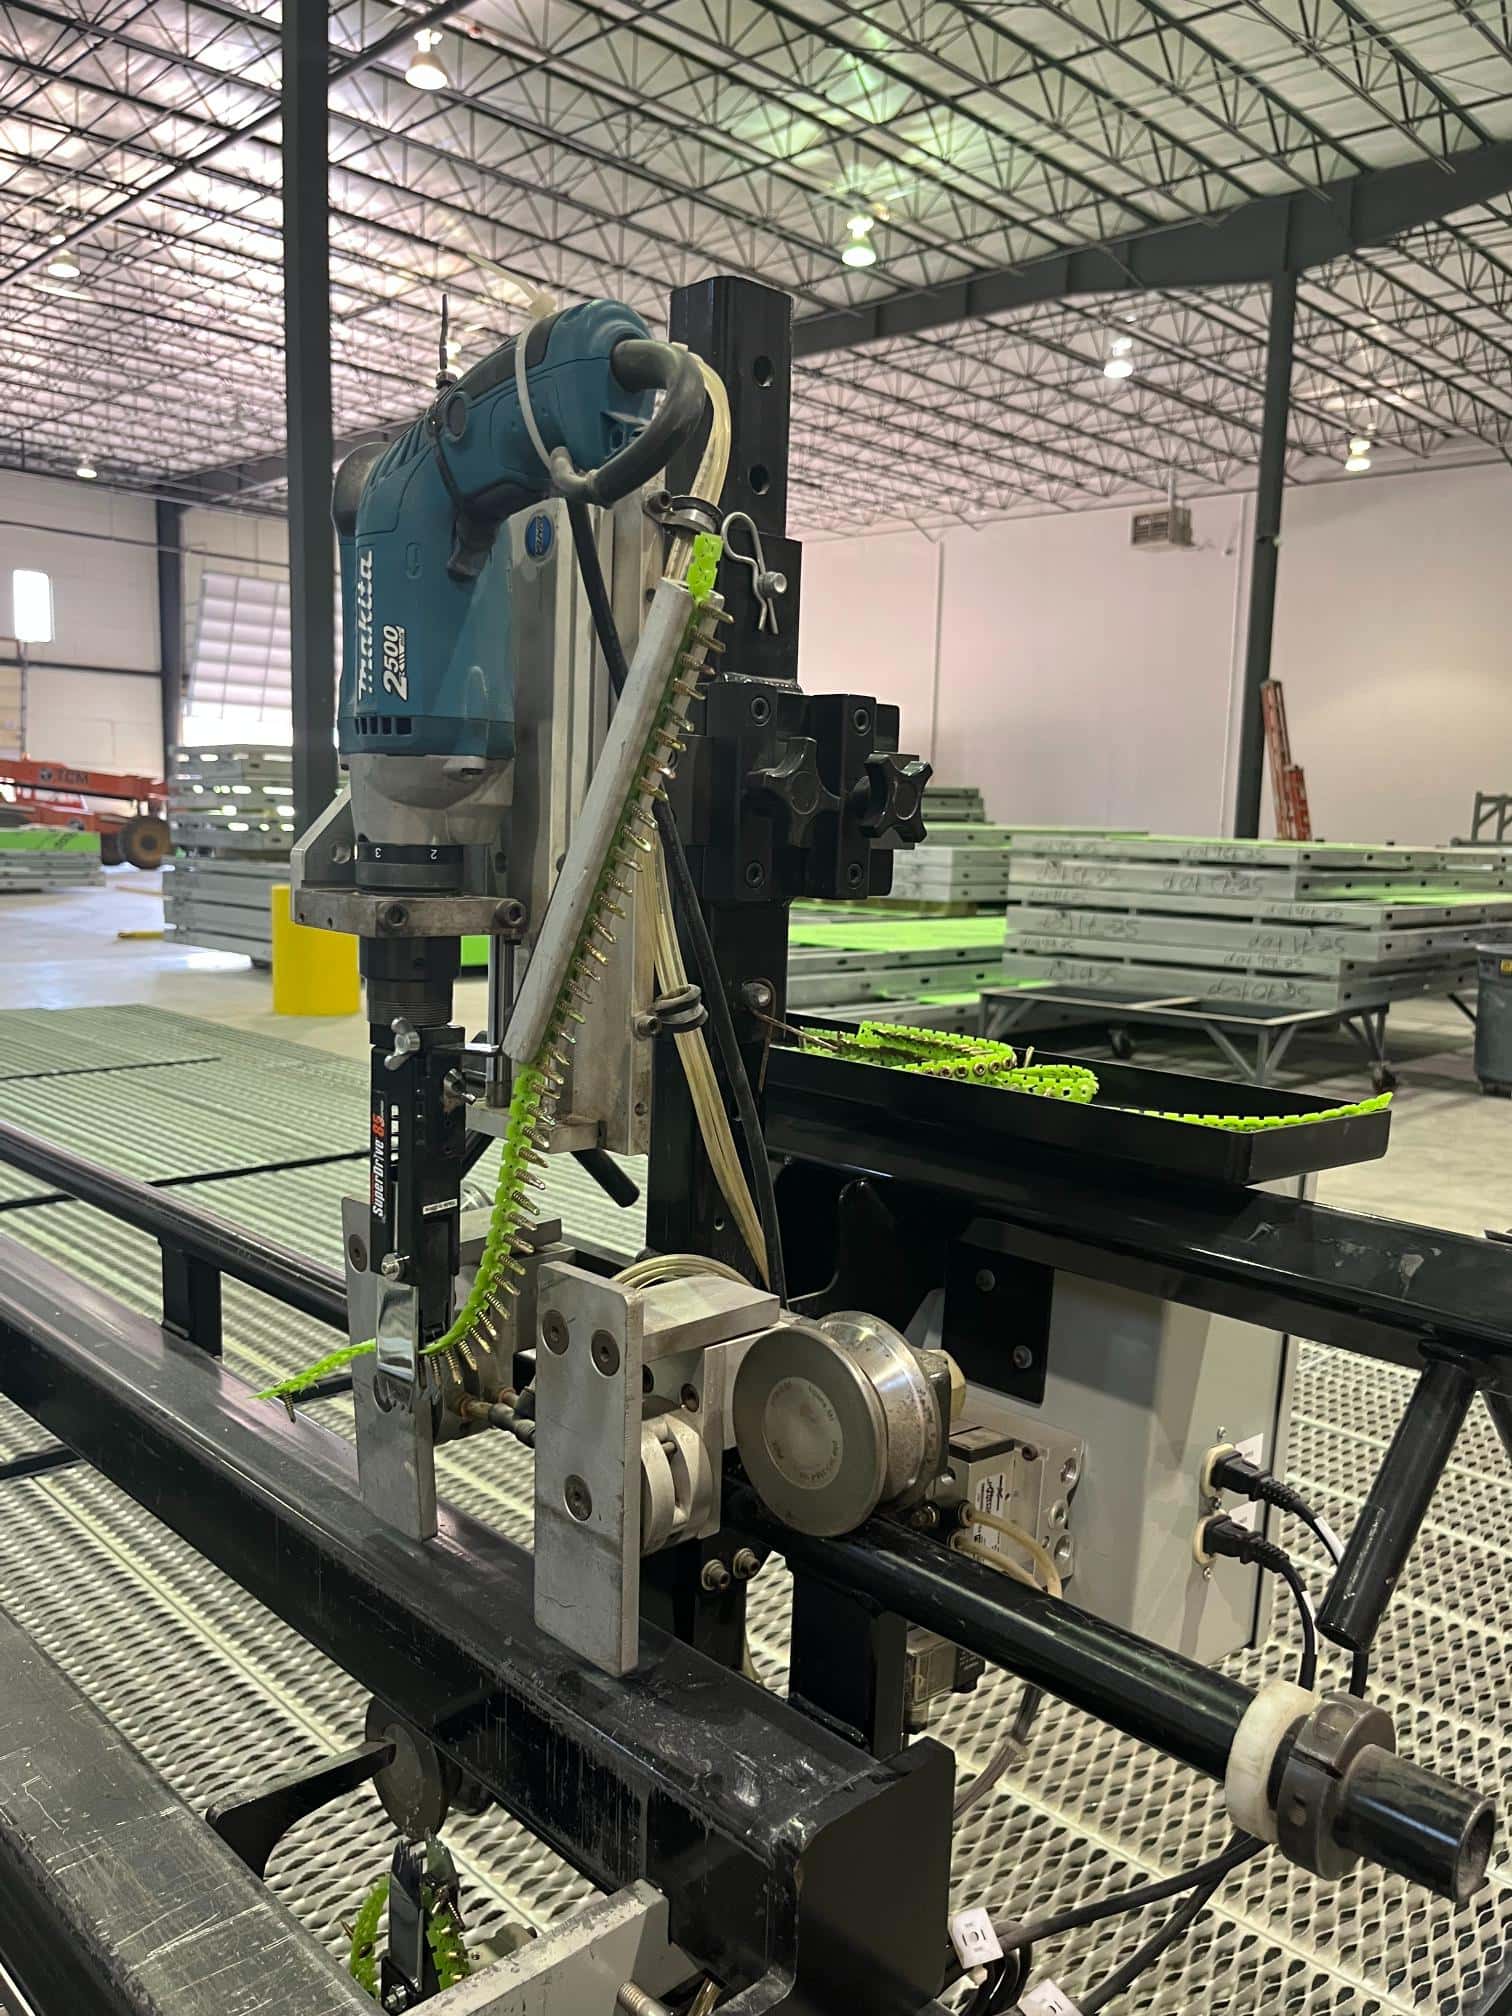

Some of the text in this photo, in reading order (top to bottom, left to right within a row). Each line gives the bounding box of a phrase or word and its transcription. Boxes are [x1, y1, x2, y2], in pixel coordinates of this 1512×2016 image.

[358, 550, 373, 701] makita
[383, 624, 408, 701] 2500
[374, 847, 382, 859] 3
[430, 849, 438, 860] 2
